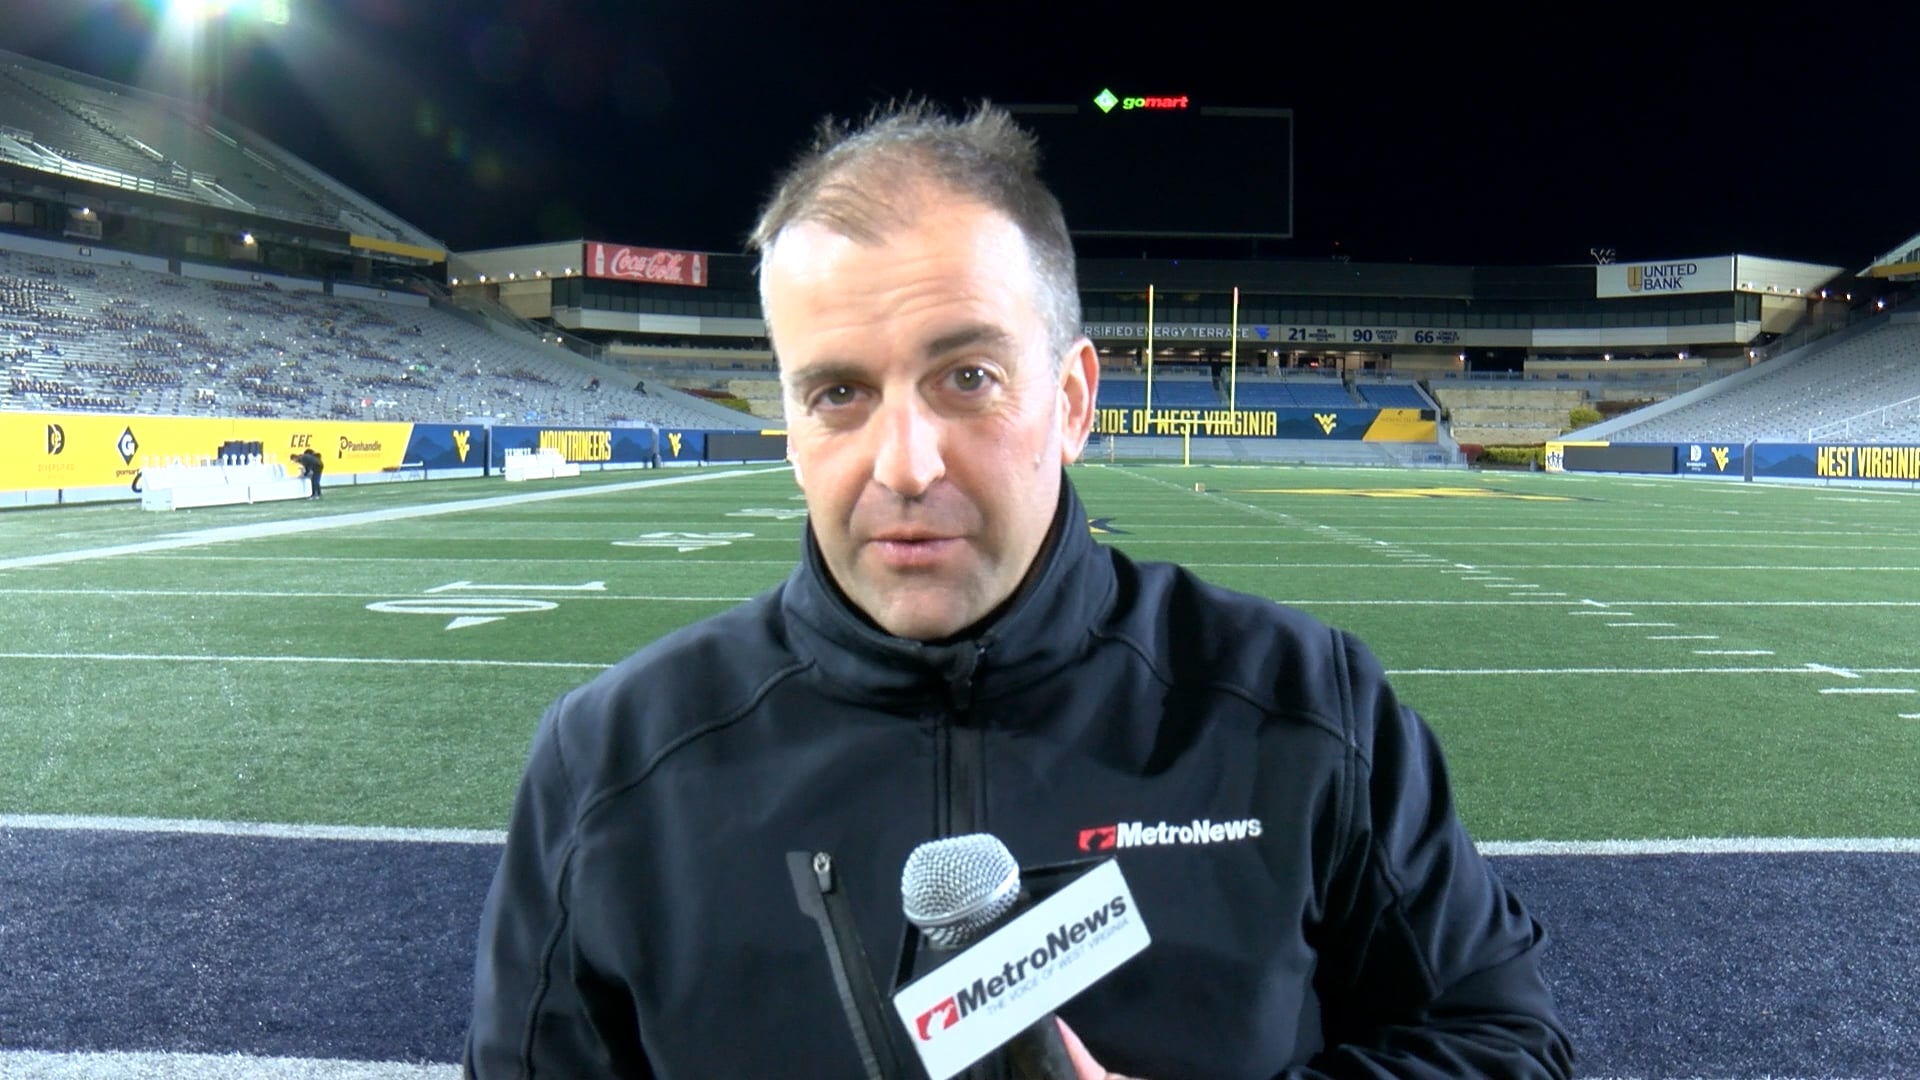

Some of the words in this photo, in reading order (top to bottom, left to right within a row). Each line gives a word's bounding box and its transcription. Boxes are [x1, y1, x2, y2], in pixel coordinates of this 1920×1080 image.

[1123, 96, 1188, 109] gomart
[1644, 263, 1697, 277] UNITED
[1644, 277, 1682, 290] BANK
[1288, 328, 1306, 340] 21
[1353, 329, 1373, 342] 90
[1415, 331, 1434, 343] 66
[1133, 409, 1153, 434] OF
[1157, 410, 1200, 435] WEST
[1204, 410, 1277, 436] VIRGINIA
[291, 434, 312, 448] CEC
[540, 431, 612, 461] MOUNTAINEERS
[1817, 446, 1854, 477] WEST
[1116, 819, 1262, 849] MetroNews
[956, 895, 1127, 1018] MetroNews
